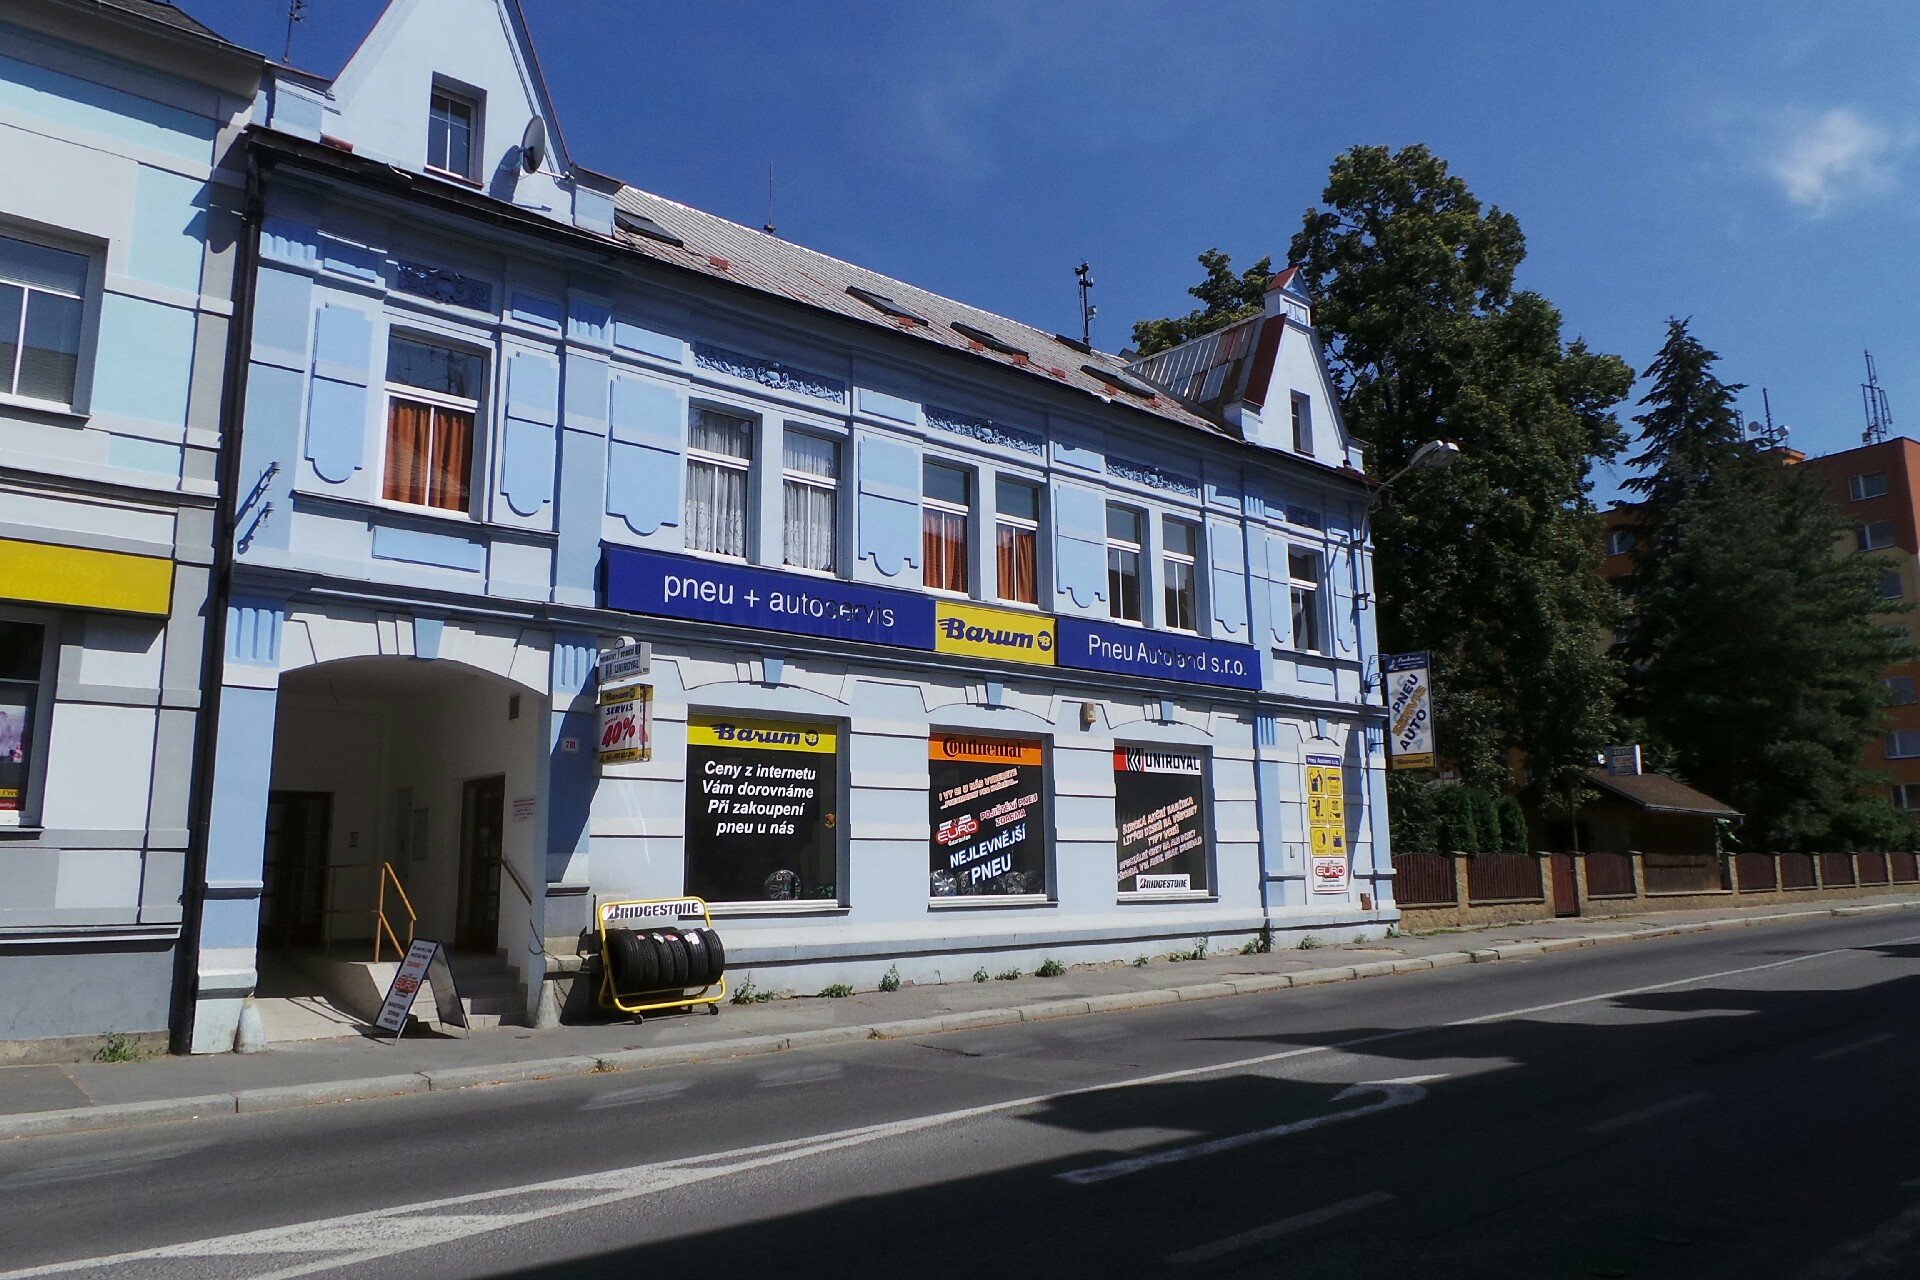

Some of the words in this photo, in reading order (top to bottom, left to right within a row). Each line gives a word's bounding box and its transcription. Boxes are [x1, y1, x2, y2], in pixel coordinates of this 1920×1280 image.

[664, 575, 734, 604] pneu
[743, 589, 760, 608] +
[769, 591, 895, 627] autoservis
[938, 618, 1034, 648] Barum
[614, 657, 640, 674] UNIROYAL
[1088, 634, 1133, 661] Pneu
[1137, 642, 1206, 671] Autoland
[1211, 656, 1247, 676] s.r.o.
[1392, 673, 1419, 714] PNEU
[606, 703, 634, 716] SERVIS
[1392, 684, 1427, 737] SERVIS
[601, 714, 636, 748] 40%
[710, 723, 800, 745] Barum
[1399, 708, 1427, 752] AUTO
[565, 741, 576, 749] 781
[942, 737, 1022, 758] Continental
[704, 760, 742, 779] Ceny
[745, 766, 753, 777] z
[756, 764, 816, 781] internetu
[1145, 752, 1200, 771] UNIROYAL
[702, 779, 734, 795] Vám
[737, 781, 814, 799] dorovnáme
[707, 799, 729, 814] Při
[732, 800, 805, 818] zakoupení
[980, 797, 1018, 821] POJIŠTĚNÍ
[1018, 792, 1039, 808] PNEU
[716, 822, 753, 836] pneu
[757, 823, 766, 834] u
[769, 820, 795, 835] nás
[995, 808, 1027, 827] ZDARMA
[937, 821, 977, 842] EURO
[949, 823, 1026, 869] NEJLEVNĚJŠÍ
[971, 853, 1012, 885] PNEU
[1316, 866, 1345, 877] EURO
[1139, 878, 1187, 889] BRIDGESTONE
[607, 902, 699, 920] BRIDGESTONE
